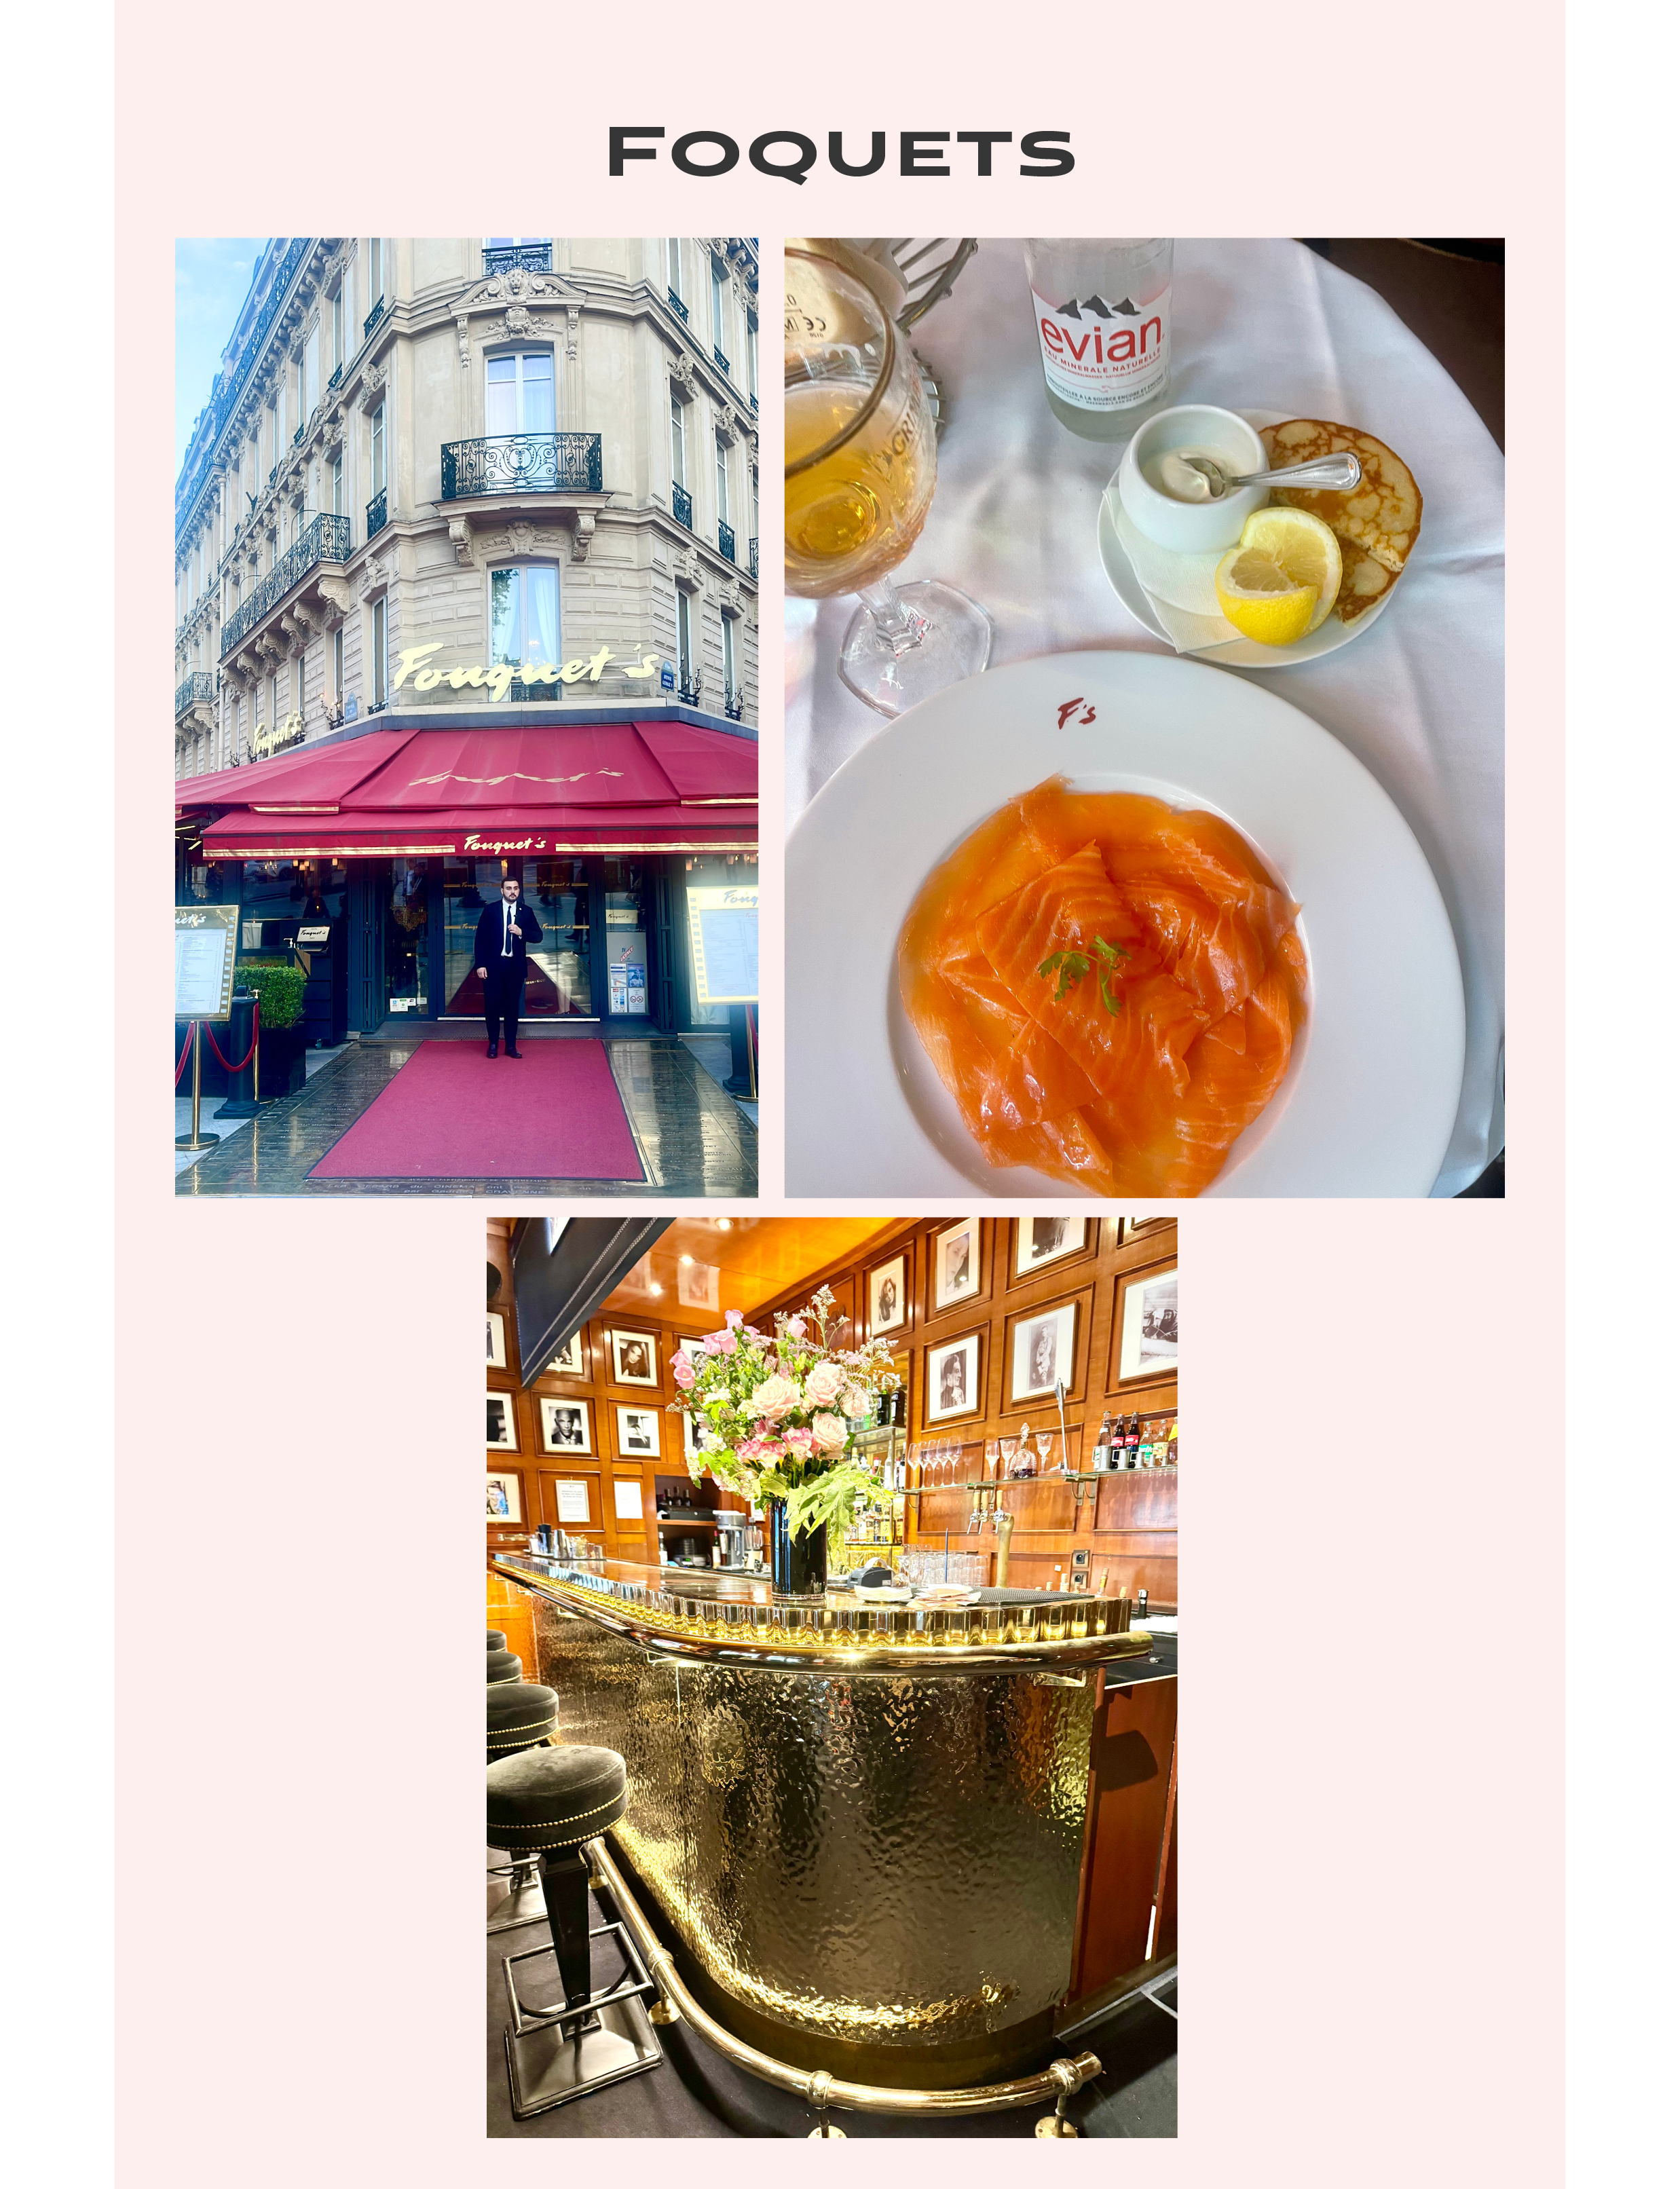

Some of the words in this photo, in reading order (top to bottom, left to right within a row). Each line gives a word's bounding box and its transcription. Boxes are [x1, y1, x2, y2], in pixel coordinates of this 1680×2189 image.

[1041, 316, 1161, 364] evian
[1044, 345, 1057, 360] EAU
[1060, 358, 1108, 373] MINERALE
[1113, 345, 1161, 373] NATURELLE
[1117, 390, 1140, 400] ENCORE
[394, 642, 659, 703] Fouquet's
[1058, 697, 1096, 730] F's
[464, 834, 546, 855] Fouquet's
[542, 923, 572, 931] Fouquet's
[620, 946, 633, 962] LICENCE
